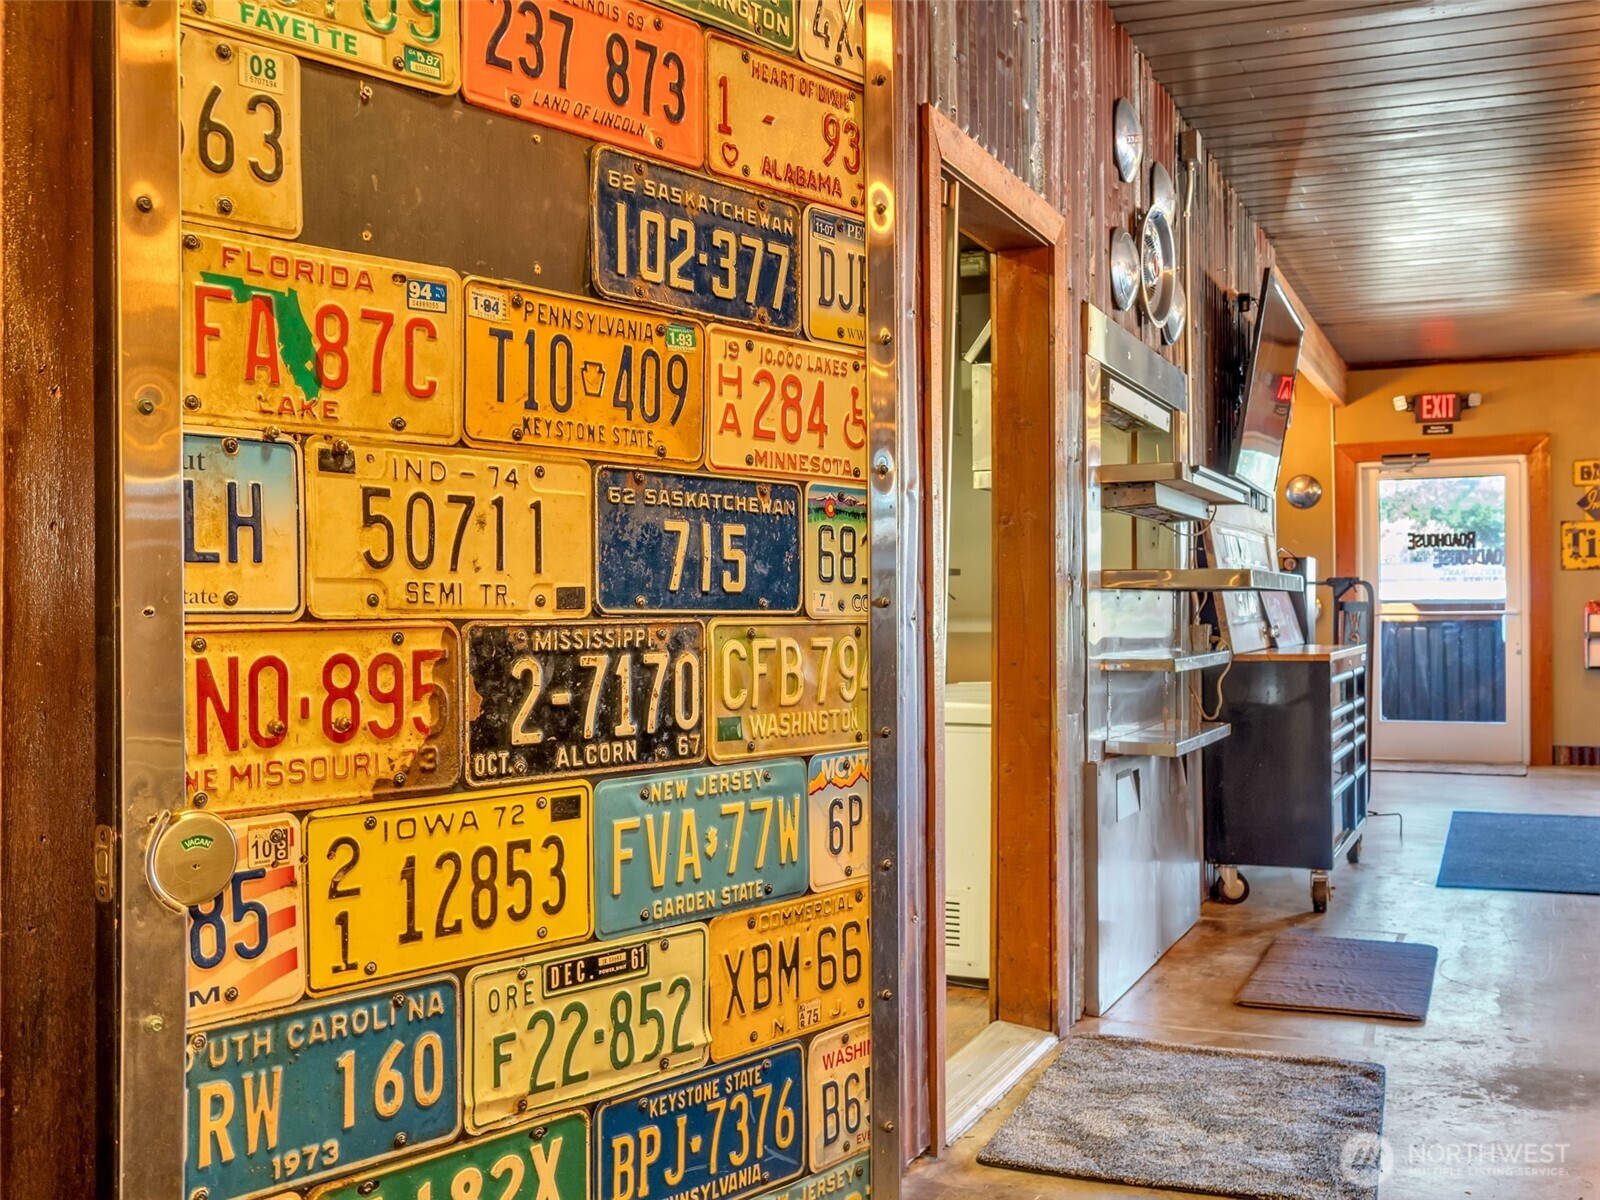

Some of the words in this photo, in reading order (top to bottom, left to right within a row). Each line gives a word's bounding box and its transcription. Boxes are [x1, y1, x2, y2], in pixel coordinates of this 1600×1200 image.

[240, 3, 358, 56] FAYETTE
[563, 0, 619, 22] INOIS
[627, 12, 644, 30] 69
[249, 54, 277, 80] 08
[486, 0, 574, 90] 237
[606, 32, 686, 124] 873
[750, 59, 796, 92] HEART
[799, 77, 815, 98] OF
[180, 82, 284, 184] 63
[532, 91, 569, 114] LAND
[573, 101, 592, 119] OF
[592, 109, 646, 137] LINCOLN
[717, 74, 733, 137] 1
[821, 111, 861, 175] 93
[760, 155, 843, 199] ALABAMA
[607, 169, 636, 193] 62
[643, 179, 795, 237] SASKATCHEWAN
[847, 221, 865, 242] PE
[221, 245, 375, 293] FLORIDA
[408, 280, 432, 301] 94
[523, 302, 654, 344] PENNSYLVANIA
[759, 346, 803, 370] 10,000
[806, 354, 849, 377] LAKES
[256, 393, 340, 420] LAKE
[752, 367, 829, 448] 284
[1422, 393, 1456, 419] EXIT
[521, 416, 606, 444] KEYSTONE
[612, 426, 656, 449] STATE
[392, 456, 448, 483] IND
[487, 464, 521, 490] 74
[754, 449, 851, 476] MINNESOTA
[607, 485, 636, 506] 62
[643, 487, 796, 517] SASKATCHEWAN
[361, 485, 544, 575] 50711
[663, 518, 746, 594] 715
[406, 580, 464, 606] SEMI
[480, 583, 516, 607] TR.
[534, 629, 652, 652] MISSISSIPPI
[722, 637, 804, 710] CFB
[511, 650, 701, 746] 2-7170
[749, 707, 858, 741] WASHINGTON
[229, 751, 380, 793] MISSOURI
[473, 751, 513, 777] OCT.
[555, 739, 638, 770] ALCORN
[677, 734, 701, 756] 67
[821, 752, 868, 781] MONT
[650, 779, 689, 803] NEW
[695, 767, 766, 797] JERSEY
[383, 809, 480, 842] IOWA
[493, 803, 525, 829] 72
[251, 839, 272, 860] 10
[398, 834, 568, 945] 12853
[651, 891, 716, 920] GARDEN
[721, 879, 765, 906] STATE
[758, 893, 854, 932] COMMERCIAL
[550, 960, 595, 990] DEC.
[630, 946, 645, 970] 61
[723, 917, 870, 1020] XBM-66
[487, 979, 535, 1014] ORE
[806, 1007, 819, 1025] 75
[286, 990, 445, 1051] CAROLINA
[197, 1065, 284, 1169] RW
[336, 1031, 445, 1130] 160
[650, 1078, 720, 1118] KEYSTONE
[724, 1066, 763, 1094] STATE
[271, 1139, 340, 1180] 1973
